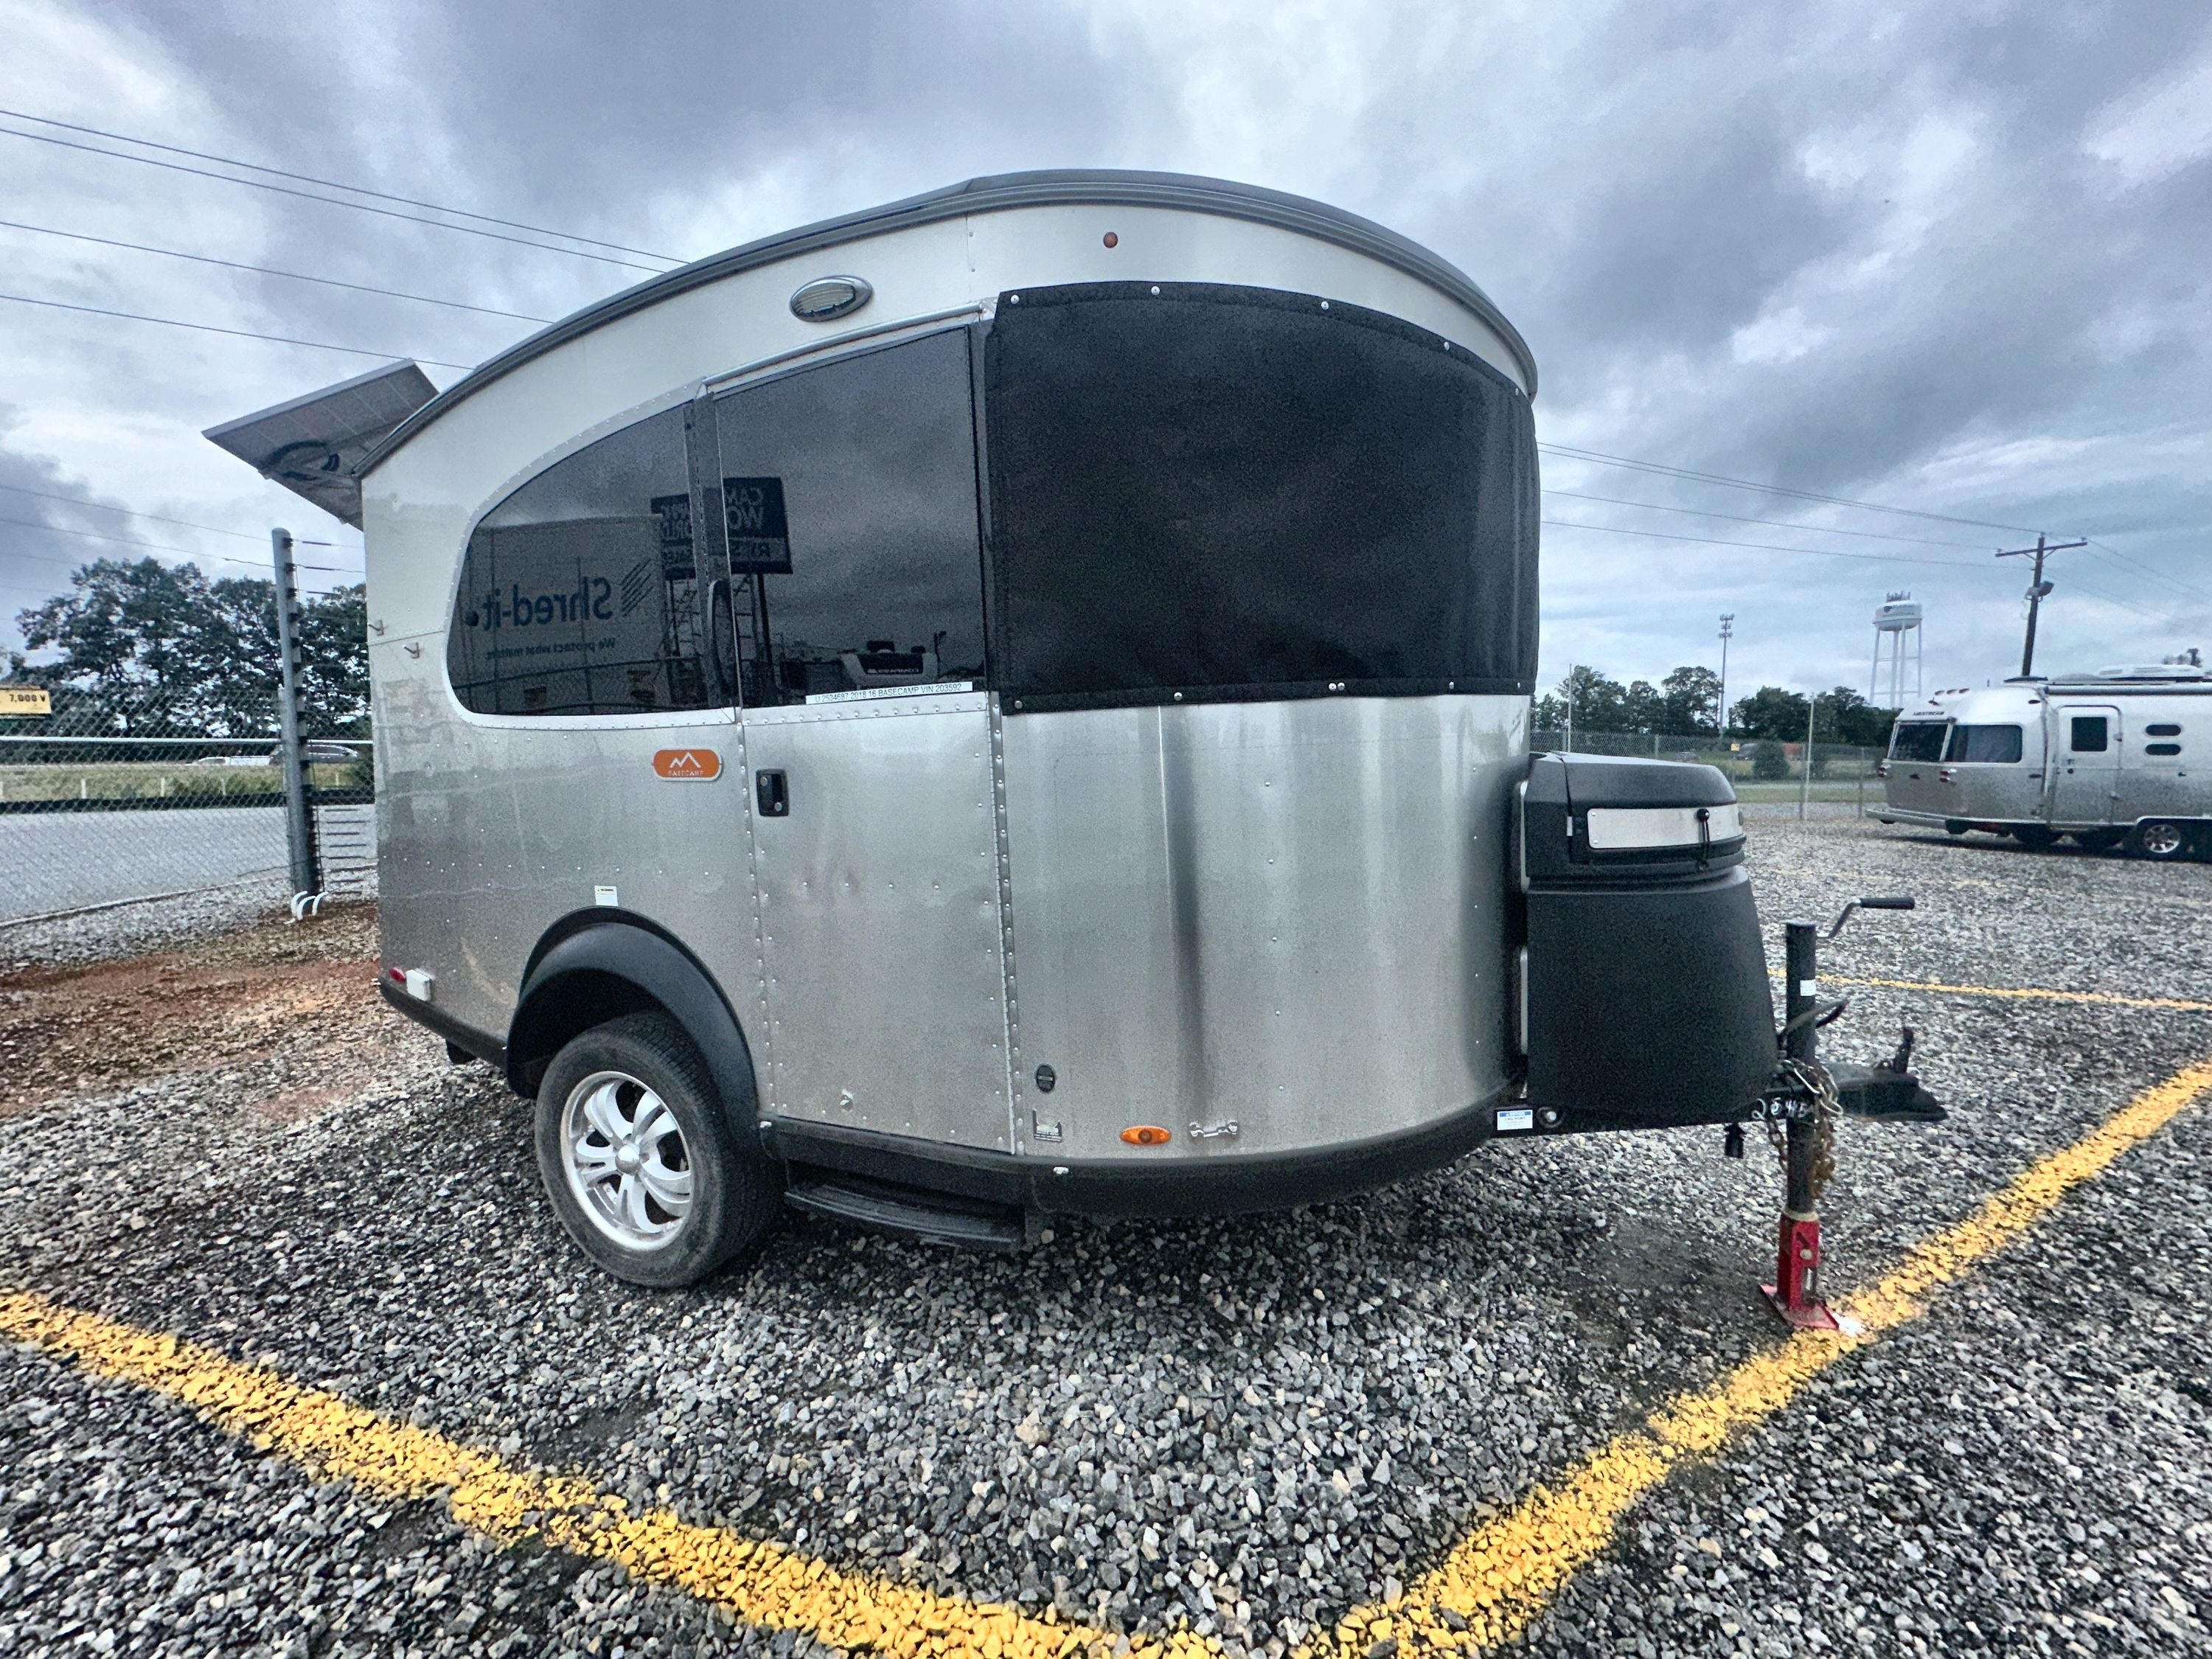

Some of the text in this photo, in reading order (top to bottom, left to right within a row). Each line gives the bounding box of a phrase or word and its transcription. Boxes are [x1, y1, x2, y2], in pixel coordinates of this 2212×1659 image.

[850, 691, 866, 700] 2018
[869, 689, 877, 698] 16
[878, 686, 919, 697] BASECAMP
[920, 685, 933, 693] VIN
[935, 683, 962, 692] 203592
